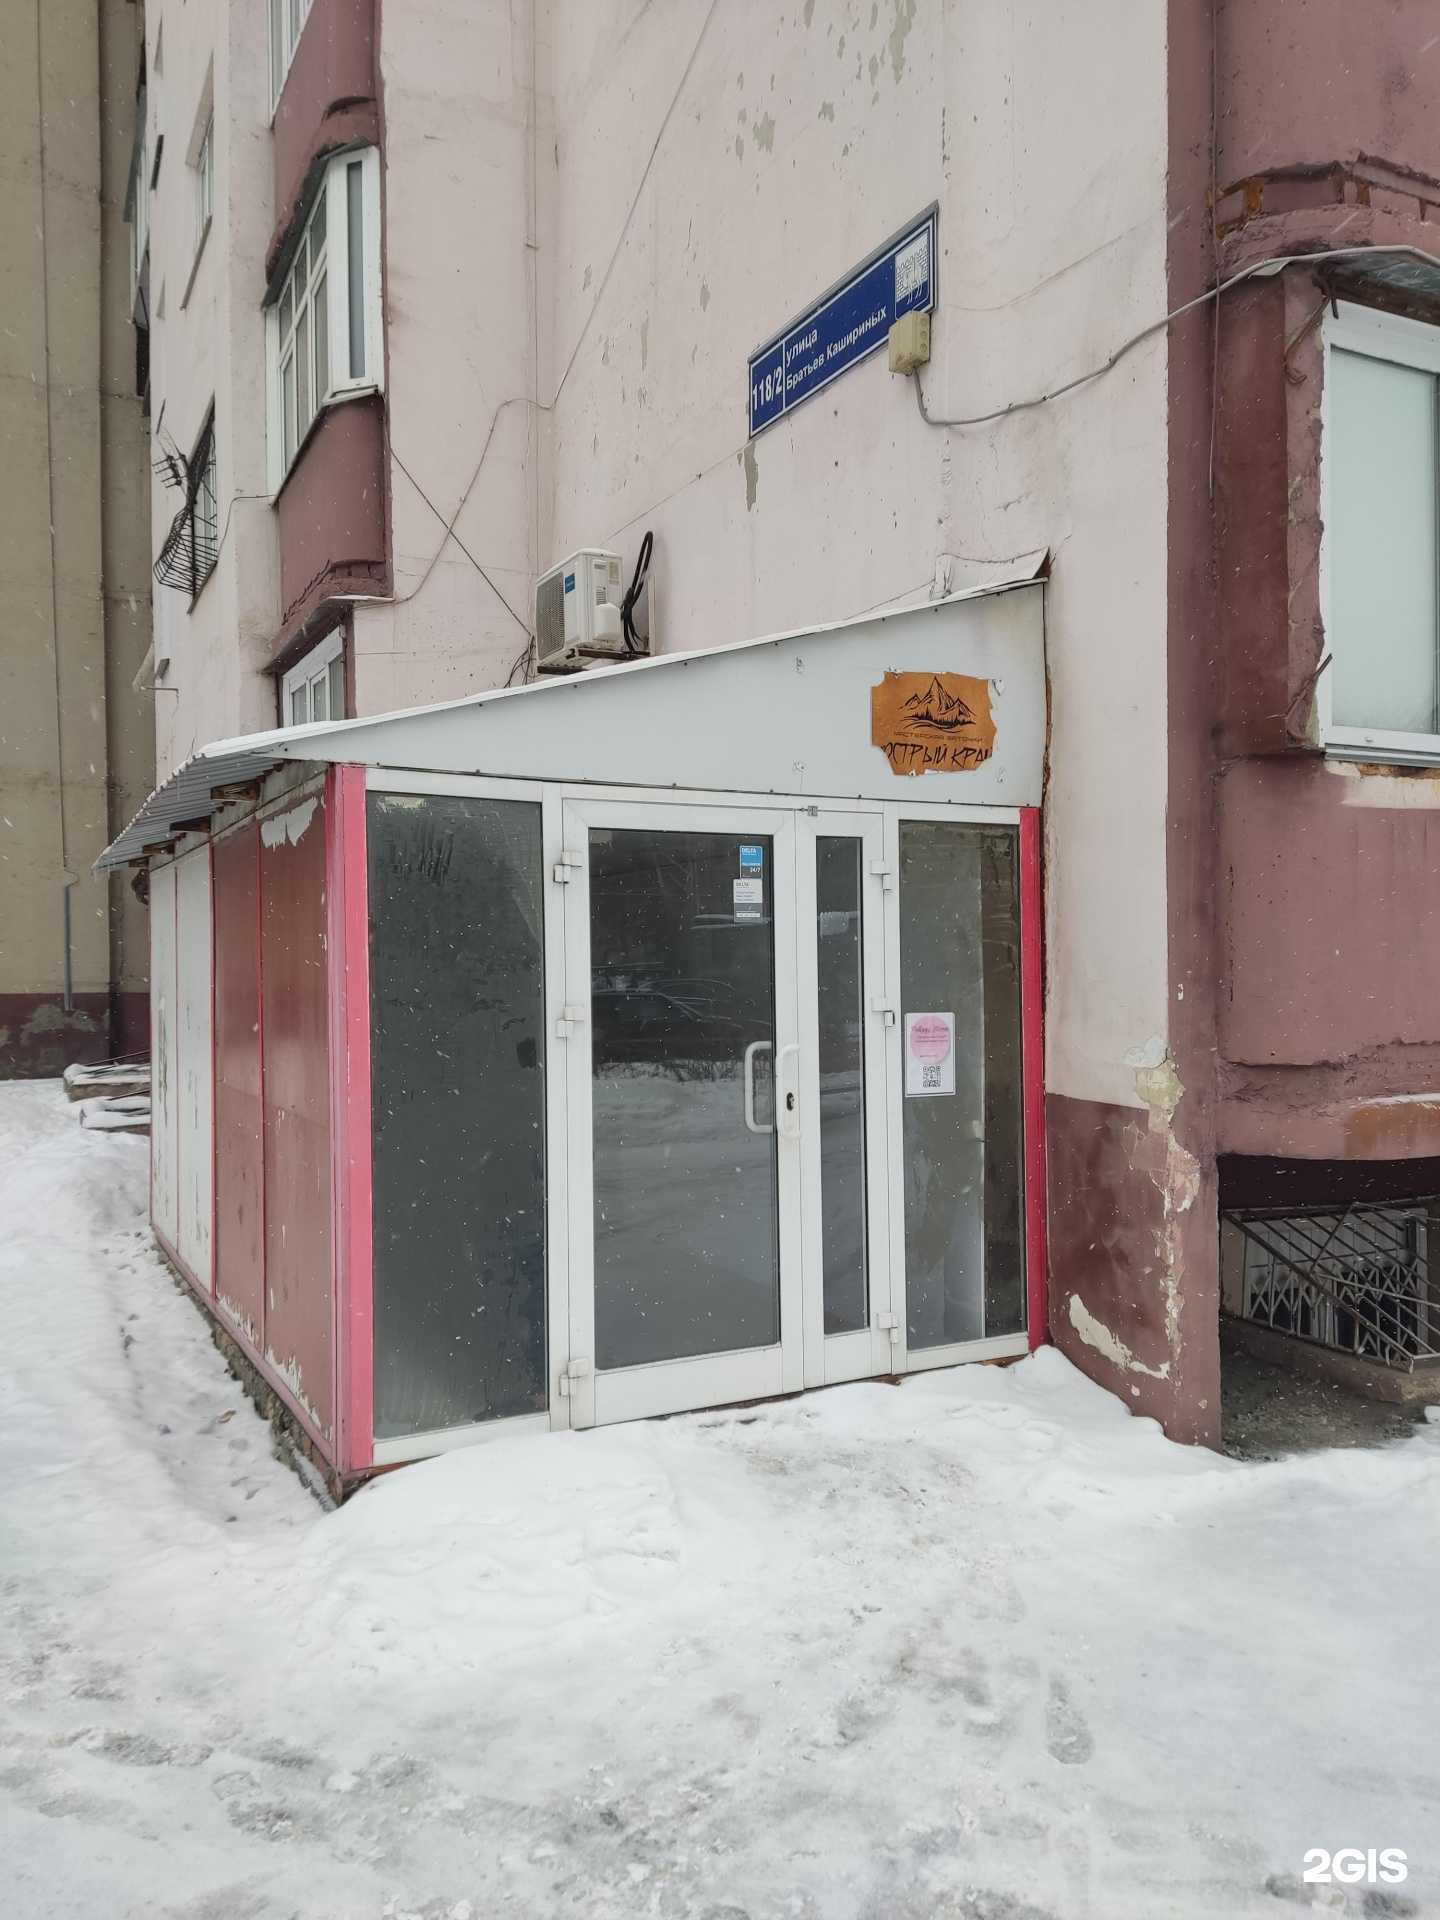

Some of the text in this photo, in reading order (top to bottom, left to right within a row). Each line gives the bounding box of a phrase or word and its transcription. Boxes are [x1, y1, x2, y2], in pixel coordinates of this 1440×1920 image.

[785, 305, 887, 390] Братьев Кашириных
[786, 329, 818, 367] улица
[752, 366, 782, 411] 118/2
